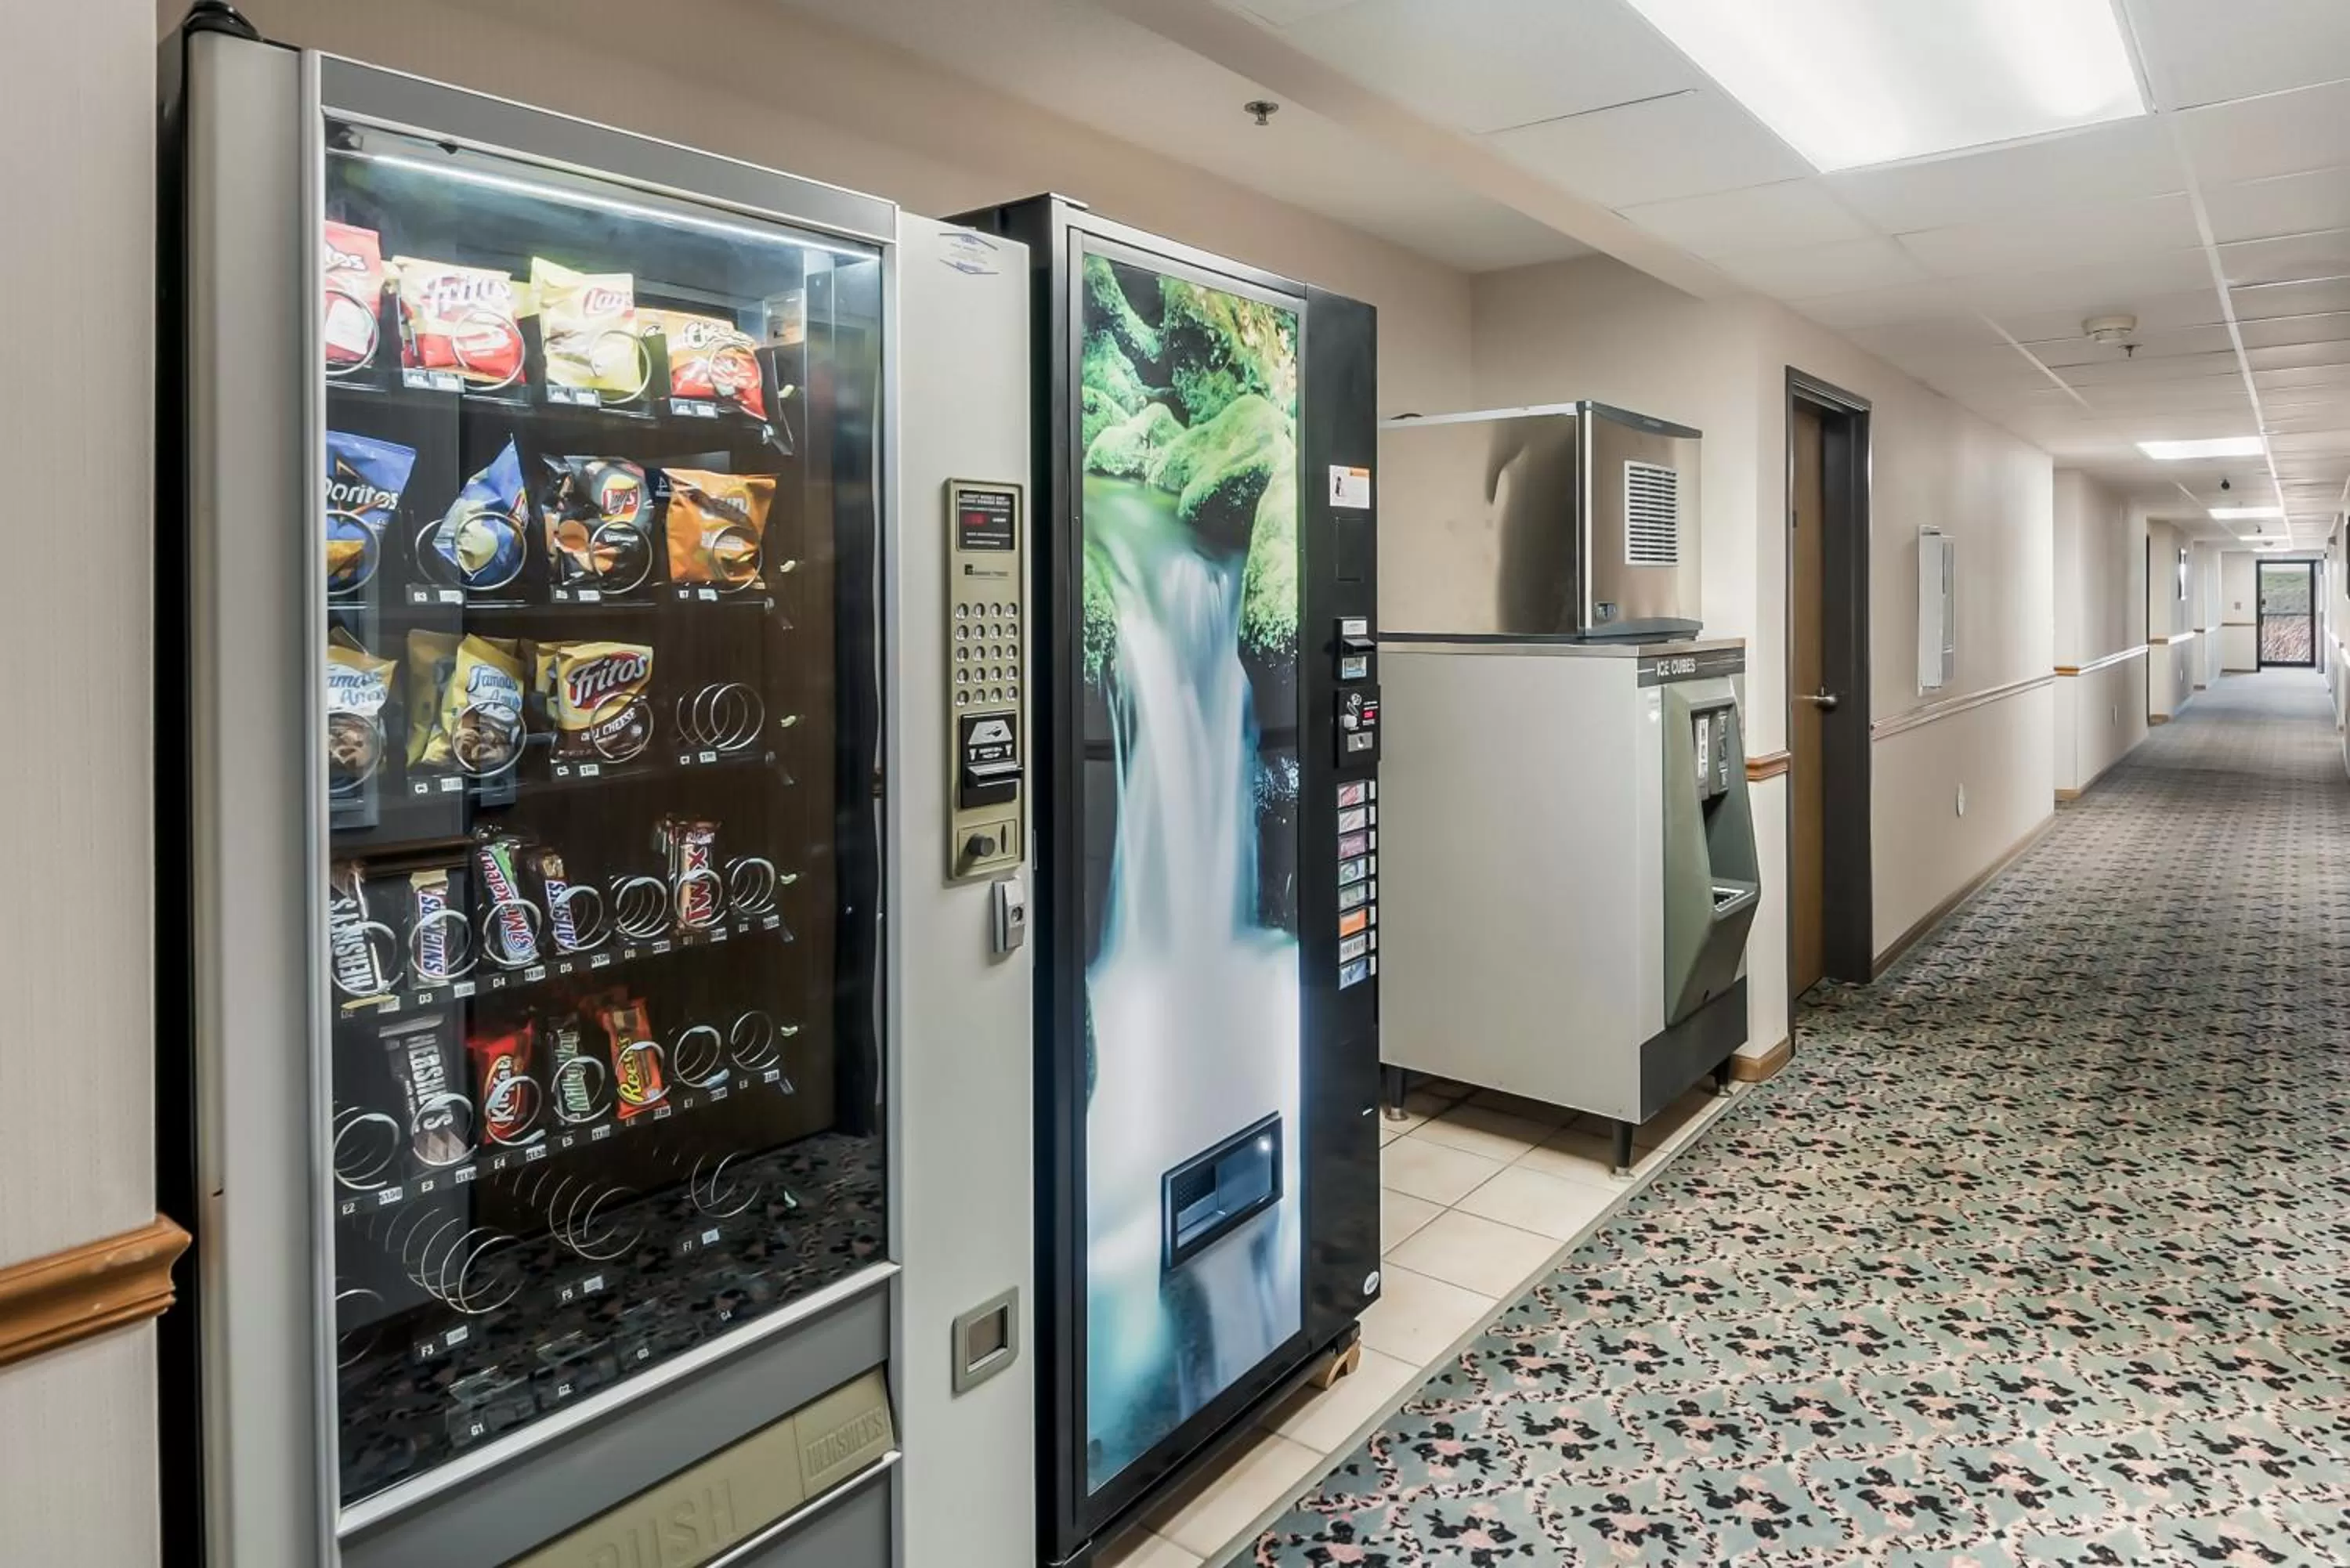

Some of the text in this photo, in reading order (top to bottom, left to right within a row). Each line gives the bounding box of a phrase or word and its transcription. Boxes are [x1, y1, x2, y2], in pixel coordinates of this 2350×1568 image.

[566, 656, 646, 707] Fritos
[1656, 657, 1697, 677] ICE CUBES
[686, 846, 711, 922] TWX
[421, 894, 444, 973] SNICKRS
[407, 1034, 454, 1129] HERSHE'S
[342, 1202, 356, 1216] E2
[421, 1343, 434, 1357] F3
